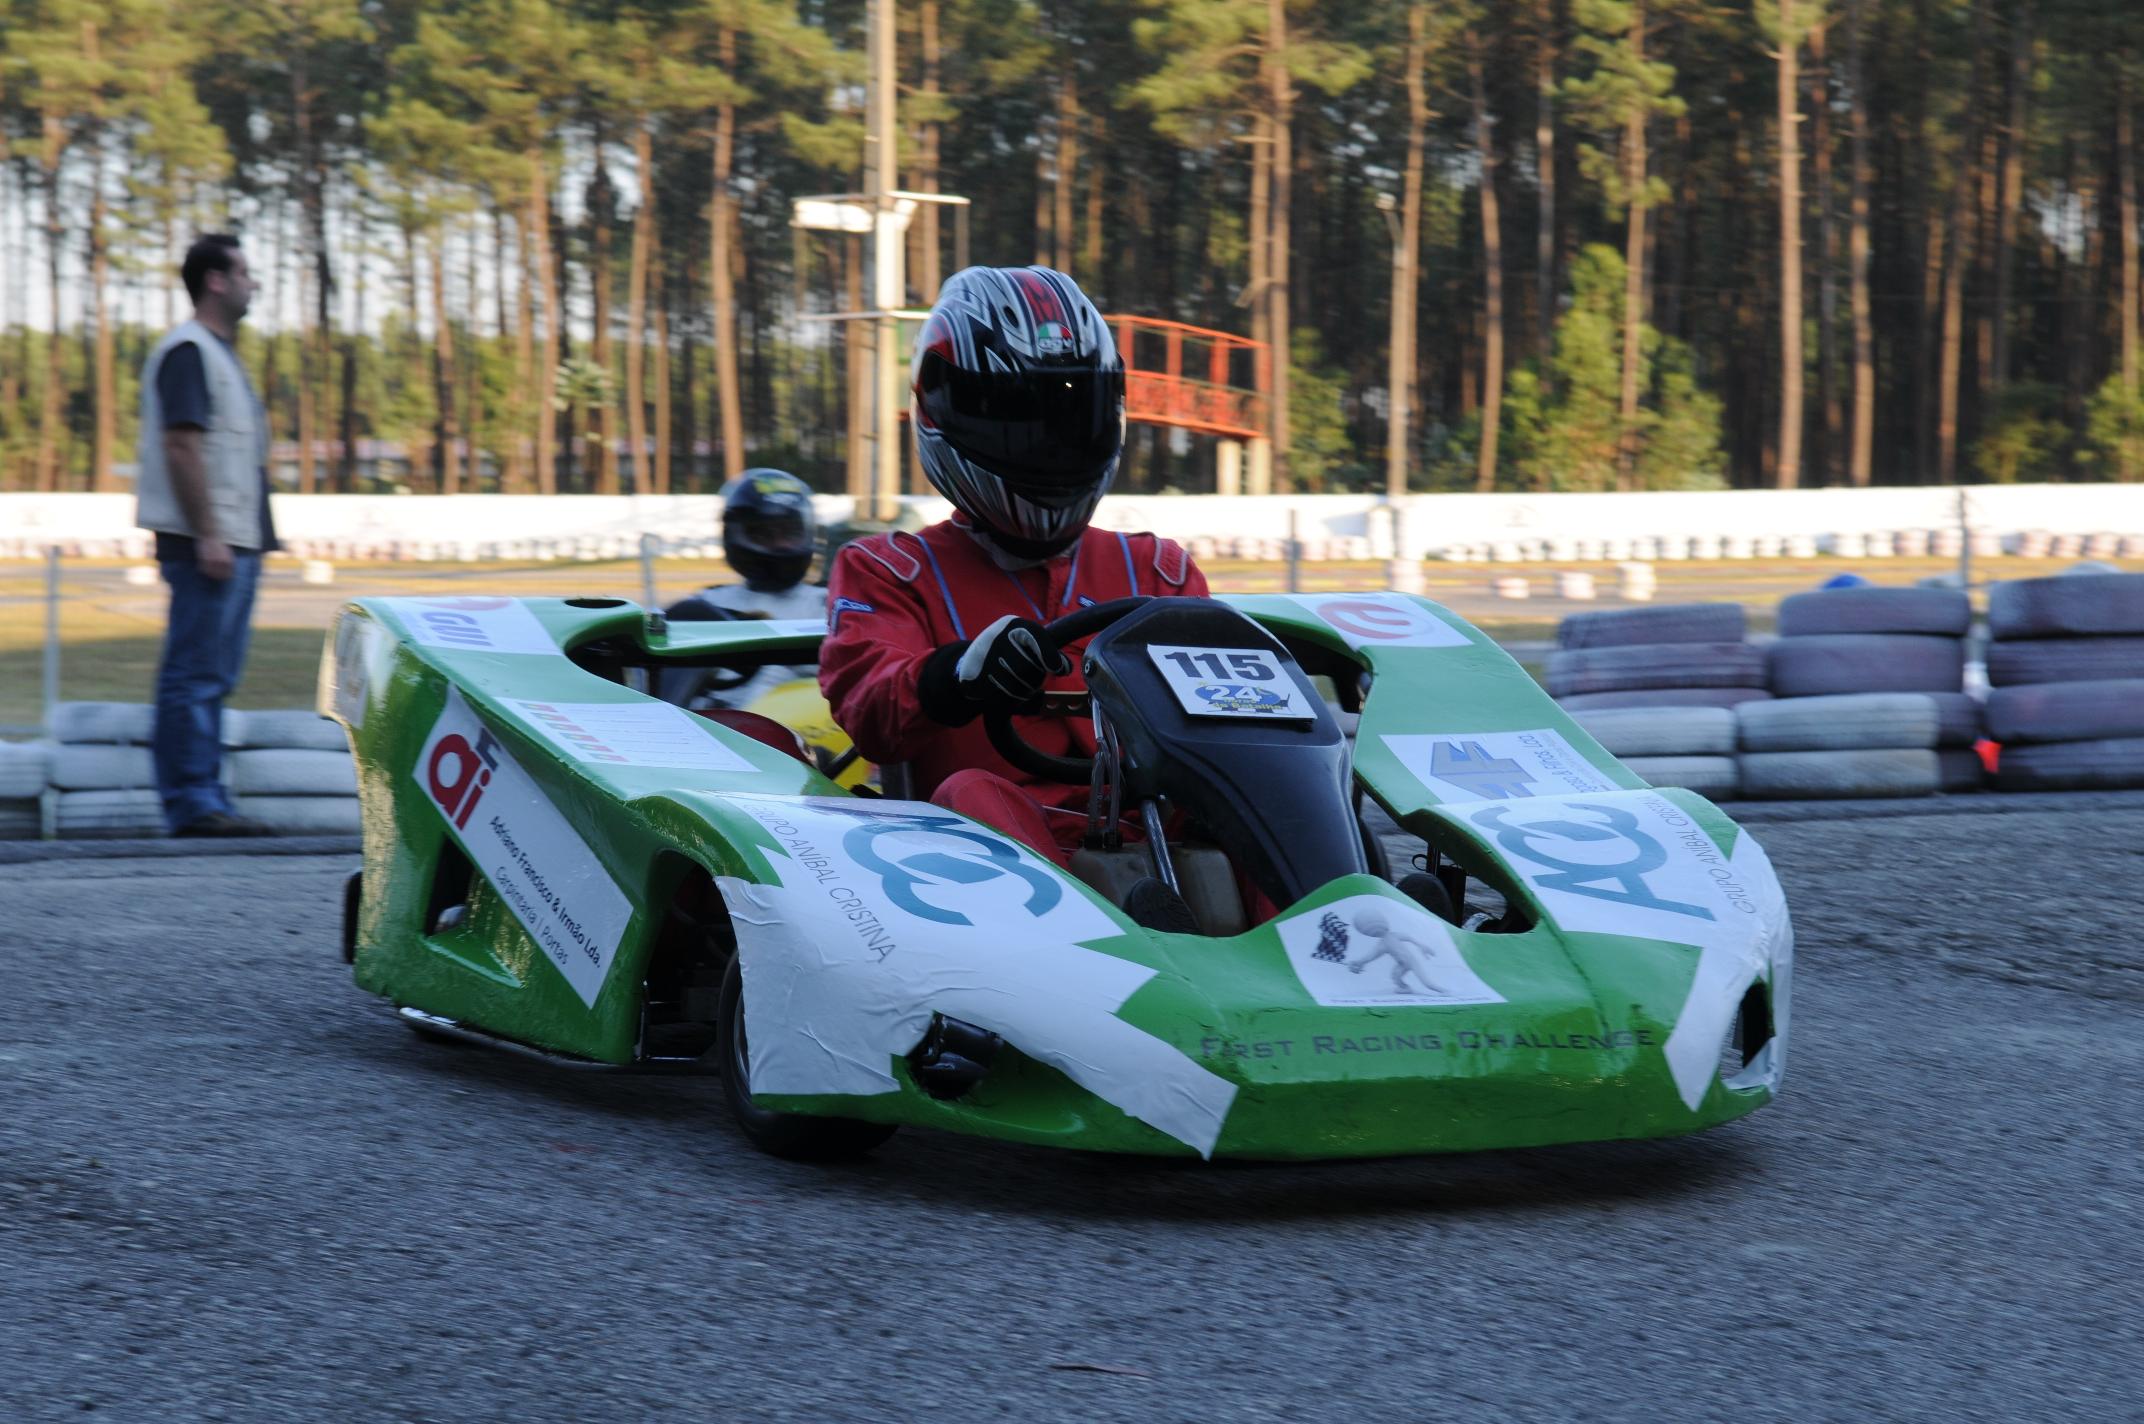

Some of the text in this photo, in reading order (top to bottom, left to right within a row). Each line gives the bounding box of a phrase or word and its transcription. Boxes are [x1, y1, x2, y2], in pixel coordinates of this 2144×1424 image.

[1165, 652, 1276, 681] 115
[1205, 685, 1263, 701] 24
[1708, 868, 1757, 914] GRUPO
[541, 925, 569, 965] Portas
[551, 897, 561, 912] &
[559, 907, 585, 945] Irmão
[584, 938, 601, 969] Lda.
[829, 886, 897, 964] CRISTINA
